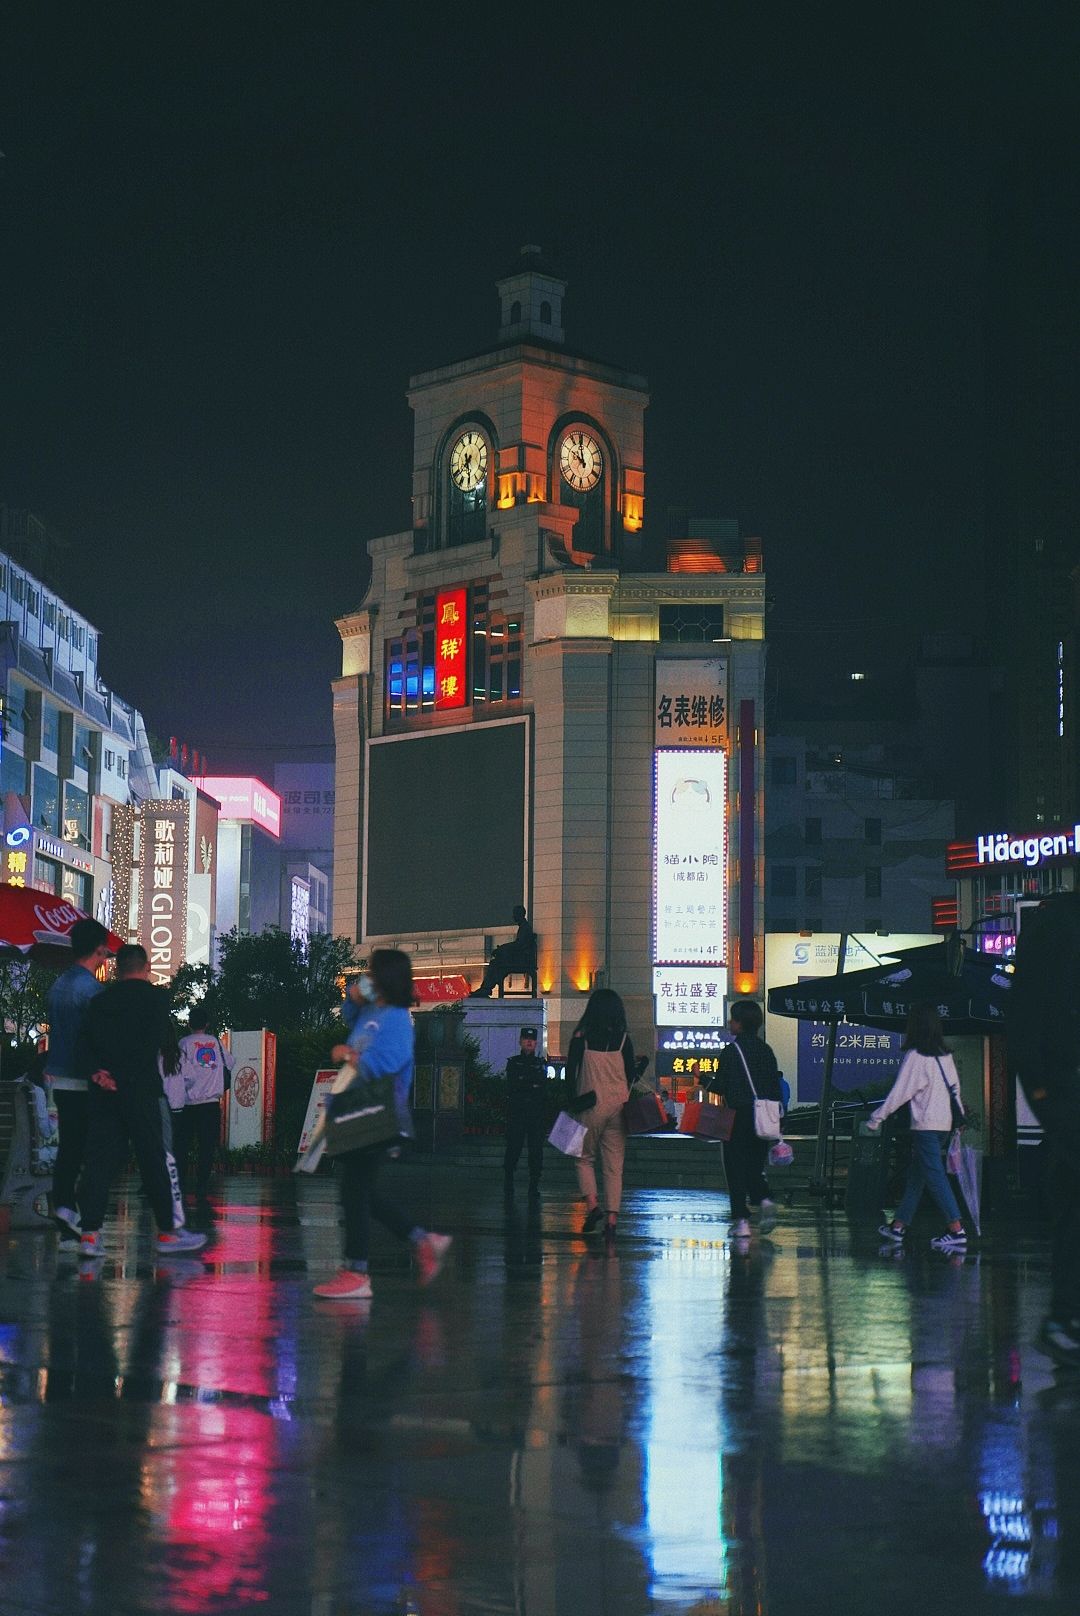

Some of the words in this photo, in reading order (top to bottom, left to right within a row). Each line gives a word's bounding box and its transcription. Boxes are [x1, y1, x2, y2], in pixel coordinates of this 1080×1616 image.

[658, 694, 725, 728] 名表维修
[711, 735, 724, 744] 5F
[153, 819, 176, 889] 歌莉娅
[664, 854, 718, 866] 猫小院
[673, 871, 708, 882] (成都店)
[150, 893, 173, 986] GLORIA
[706, 945, 718, 954] 4F
[660, 982, 718, 998] 克拉盛宴
[667, 1002, 710, 1014] 珠宝定制
[711, 1016, 721, 1024] 2F
[811, 1033, 891, 1049] 约.2米层高
